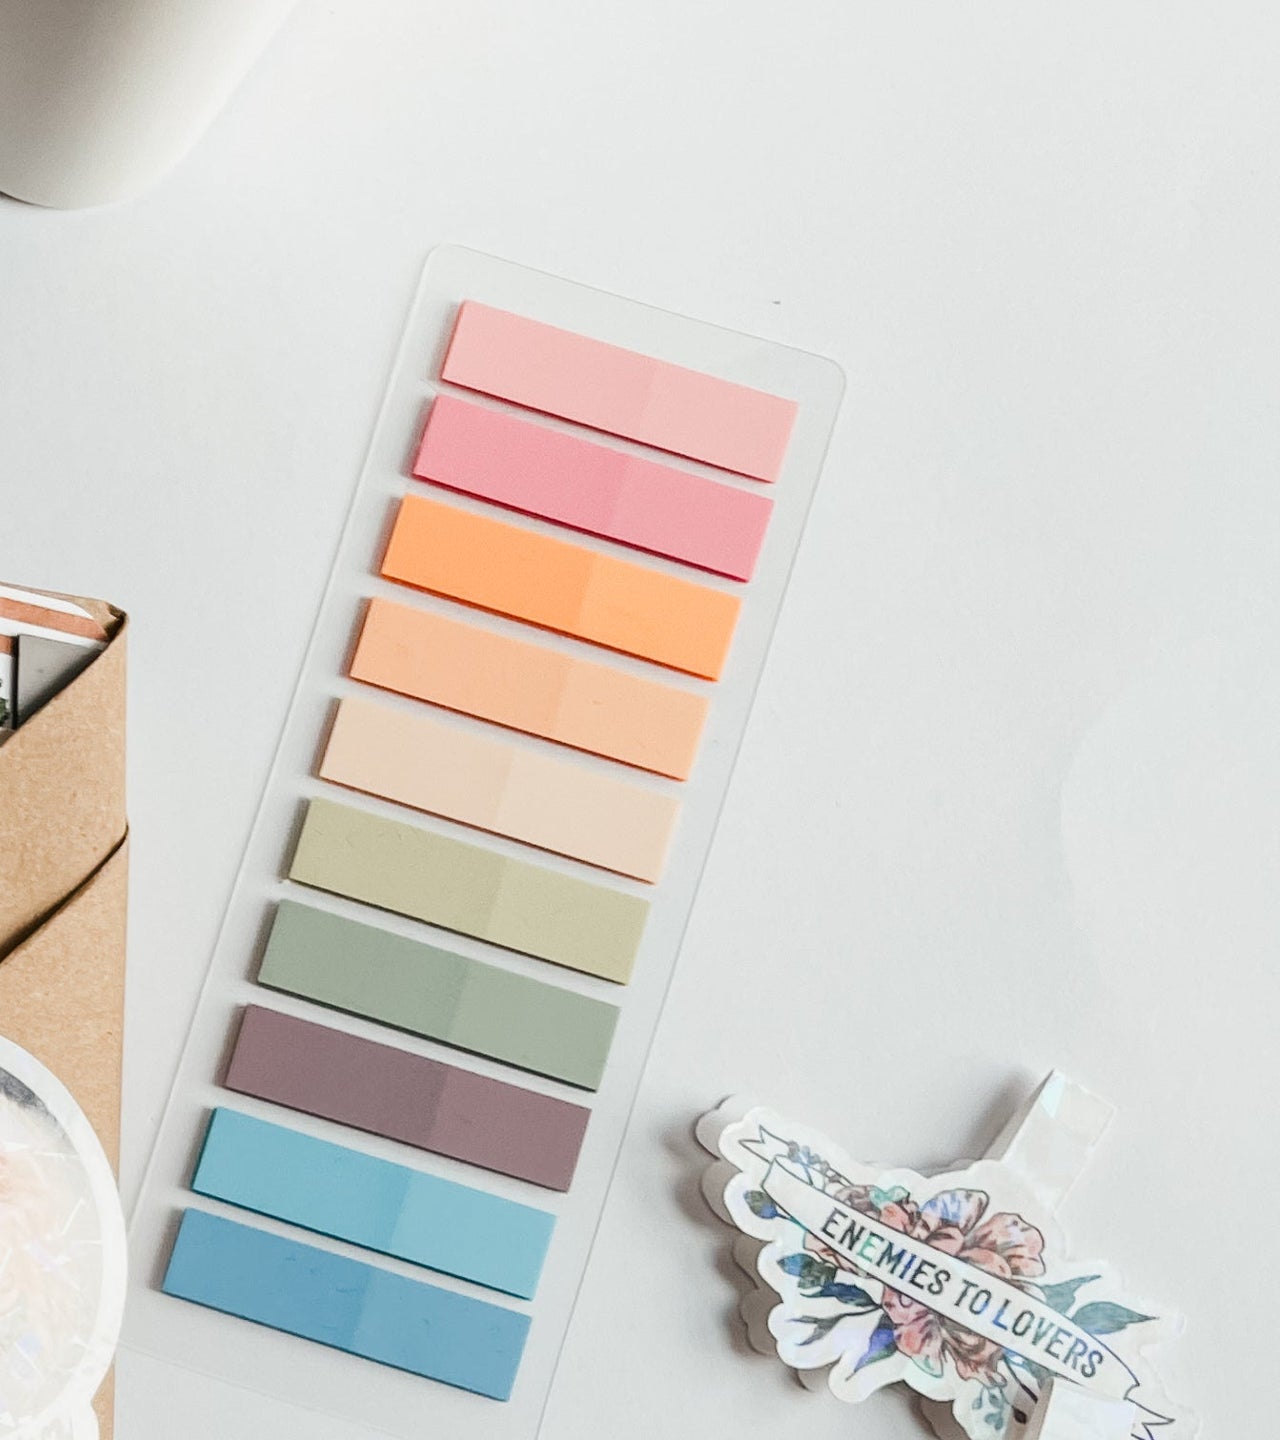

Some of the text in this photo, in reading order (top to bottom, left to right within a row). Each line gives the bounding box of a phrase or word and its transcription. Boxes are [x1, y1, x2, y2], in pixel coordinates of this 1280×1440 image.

[820, 1206, 1104, 1379] ENEMIES TO LOVERS
